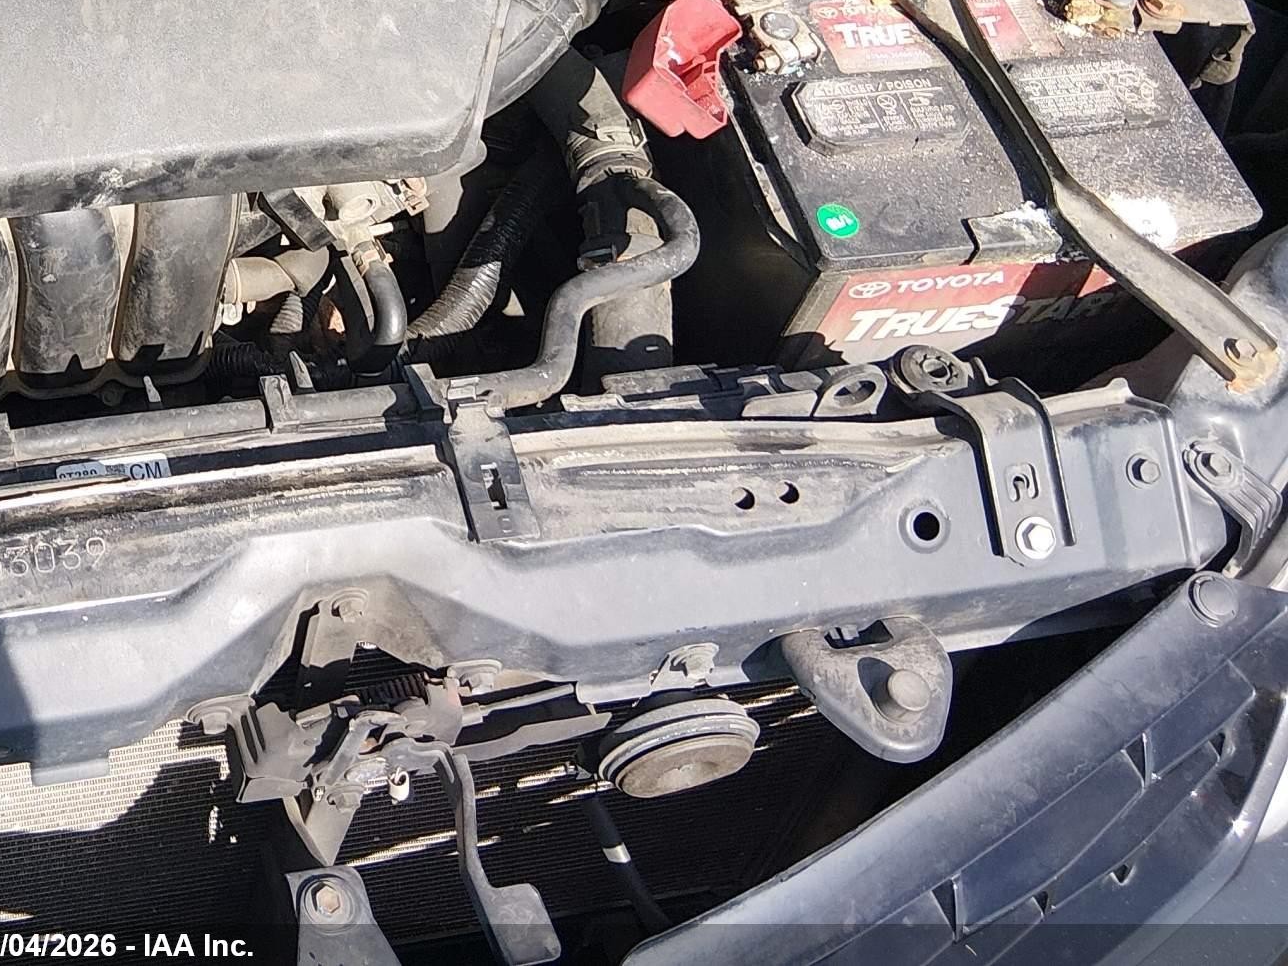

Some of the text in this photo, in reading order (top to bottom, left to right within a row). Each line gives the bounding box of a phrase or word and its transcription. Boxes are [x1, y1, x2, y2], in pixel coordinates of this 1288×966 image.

[825, 83, 875, 97] DANGER
[887, 78, 932, 90] POISON
[896, 270, 1005, 295] TOYOTA
[129, 461, 162, 481] CM
